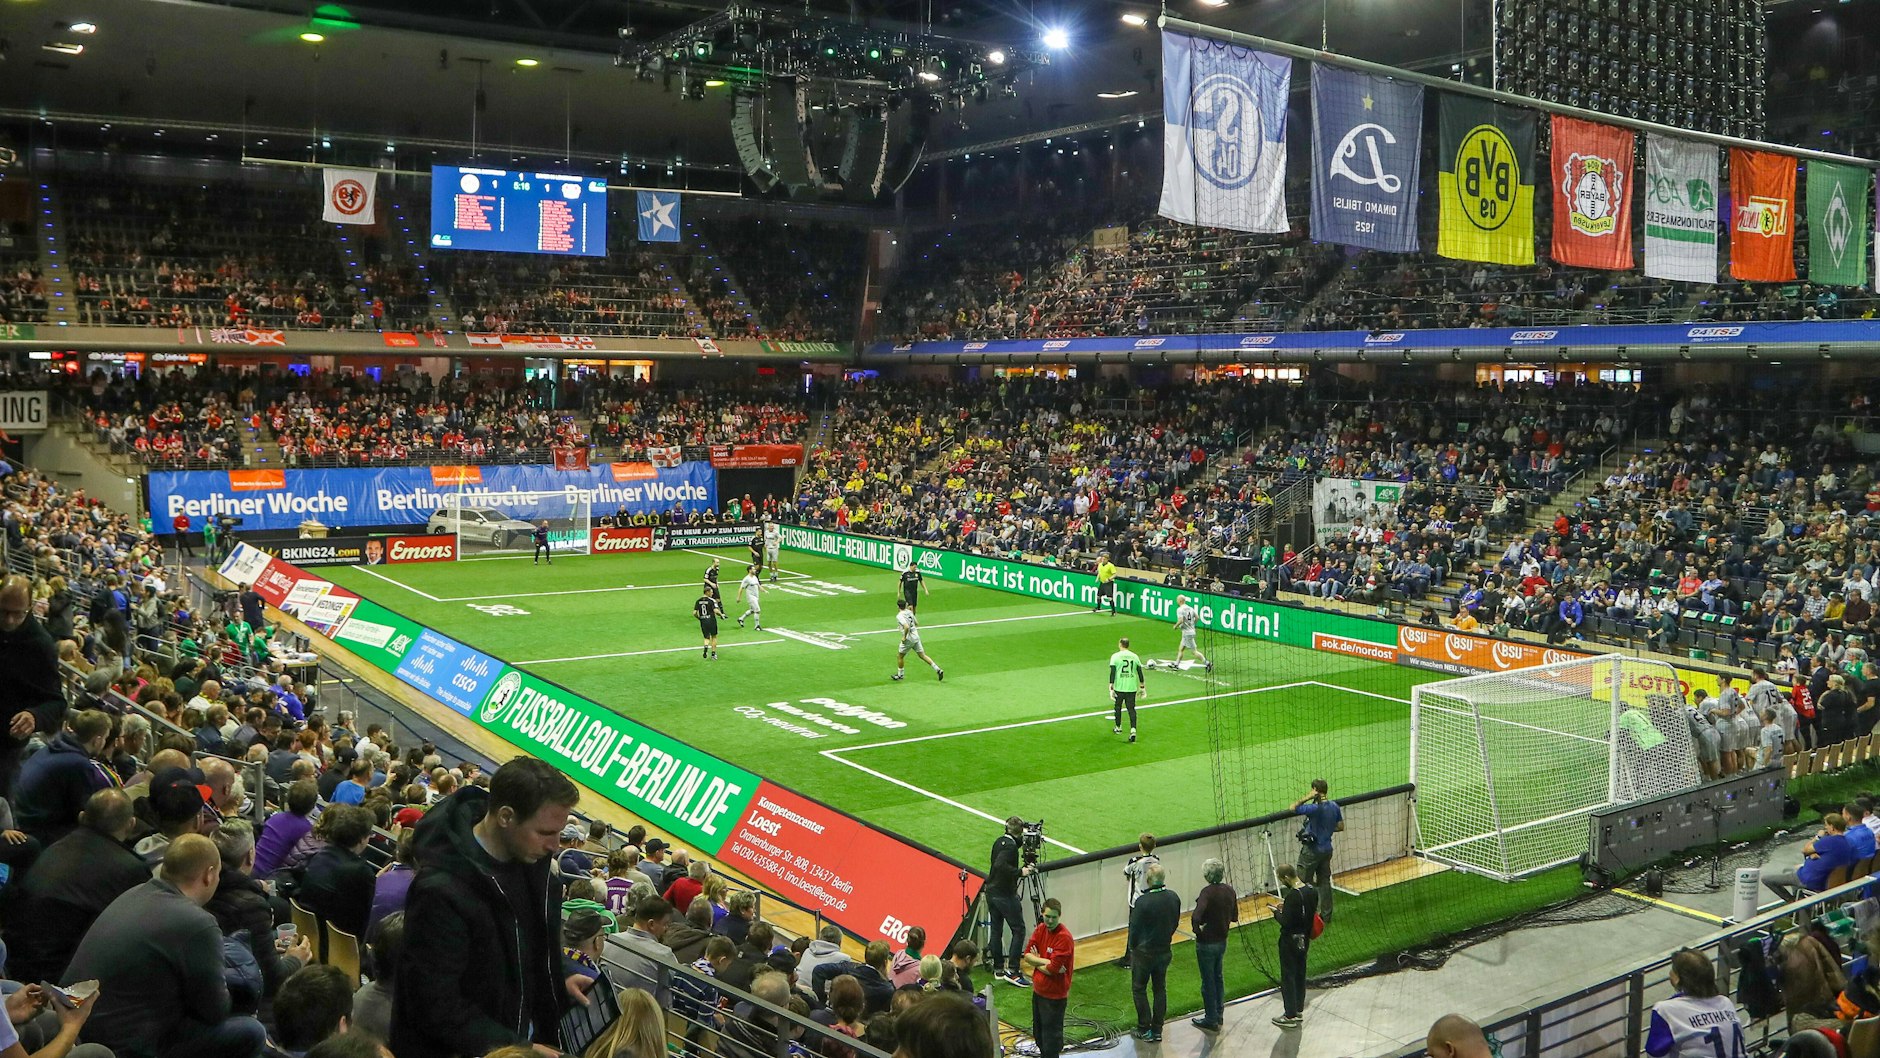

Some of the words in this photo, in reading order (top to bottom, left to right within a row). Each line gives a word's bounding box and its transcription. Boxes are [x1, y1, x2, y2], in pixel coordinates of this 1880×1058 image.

[778, 341, 840, 354] BERLINER
[0, 396, 41, 424] ING
[168, 493, 264, 517] Berliner
[267, 490, 348, 514] Woche
[466, 485, 539, 507] Woche
[564, 483, 642, 505] Berliner
[644, 481, 708, 501] Woche
[671, 538, 686, 546] AOK
[688, 535, 756, 545] TRADITIONSMASTE
[718, 526, 733, 534] ZUM
[390, 540, 452, 561] Emons
[594, 532, 650, 551] Emons
[781, 527, 892, 565] FUSSBALLGOLF-BERLIN.DE
[282, 546, 360, 559] BKING24.com
[917, 550, 943, 570] AOK
[959, 559, 998, 586] Jetzt
[1003, 565, 1024, 591] ist
[1029, 575, 1075, 600] noch
[1140, 588, 1173, 617] für
[1183, 596, 1213, 625] ie
[1220, 603, 1280, 638] drin!
[1407, 629, 1428, 644] BSU
[1453, 637, 1473, 651] BSU
[1321, 639, 1393, 660] aok.de/nordost
[1501, 643, 1523, 660] BSU
[1121, 659, 1134, 674] 21
[1409, 657, 1420, 665] Wir
[1420, 660, 1443, 670] machen
[1444, 664, 1459, 672] NEU.
[1460, 665, 1470, 674] Die
[451, 672, 478, 693] CISCO
[502, 686, 742, 836] FUSSBALLGOLF-BERLIN.DE
[747, 810, 782, 837] Loest
[757, 796, 826, 835] Kompetenzcenter
[739, 828, 784, 857] Oranienburger
[782, 850, 794, 864] Str.
[793, 856, 810, 873] 80B,
[809, 863, 834, 883] 13437
[831, 877, 854, 895] Berlin
[731, 841, 742, 854] Tel
[740, 846, 755, 861] 030
[753, 853, 786, 879] 435588-0,
[784, 870, 848, 912] tino.loest@ergo.de
[879, 914, 912, 944] ERG
[1688, 1010, 1728, 1028] HERTHA
